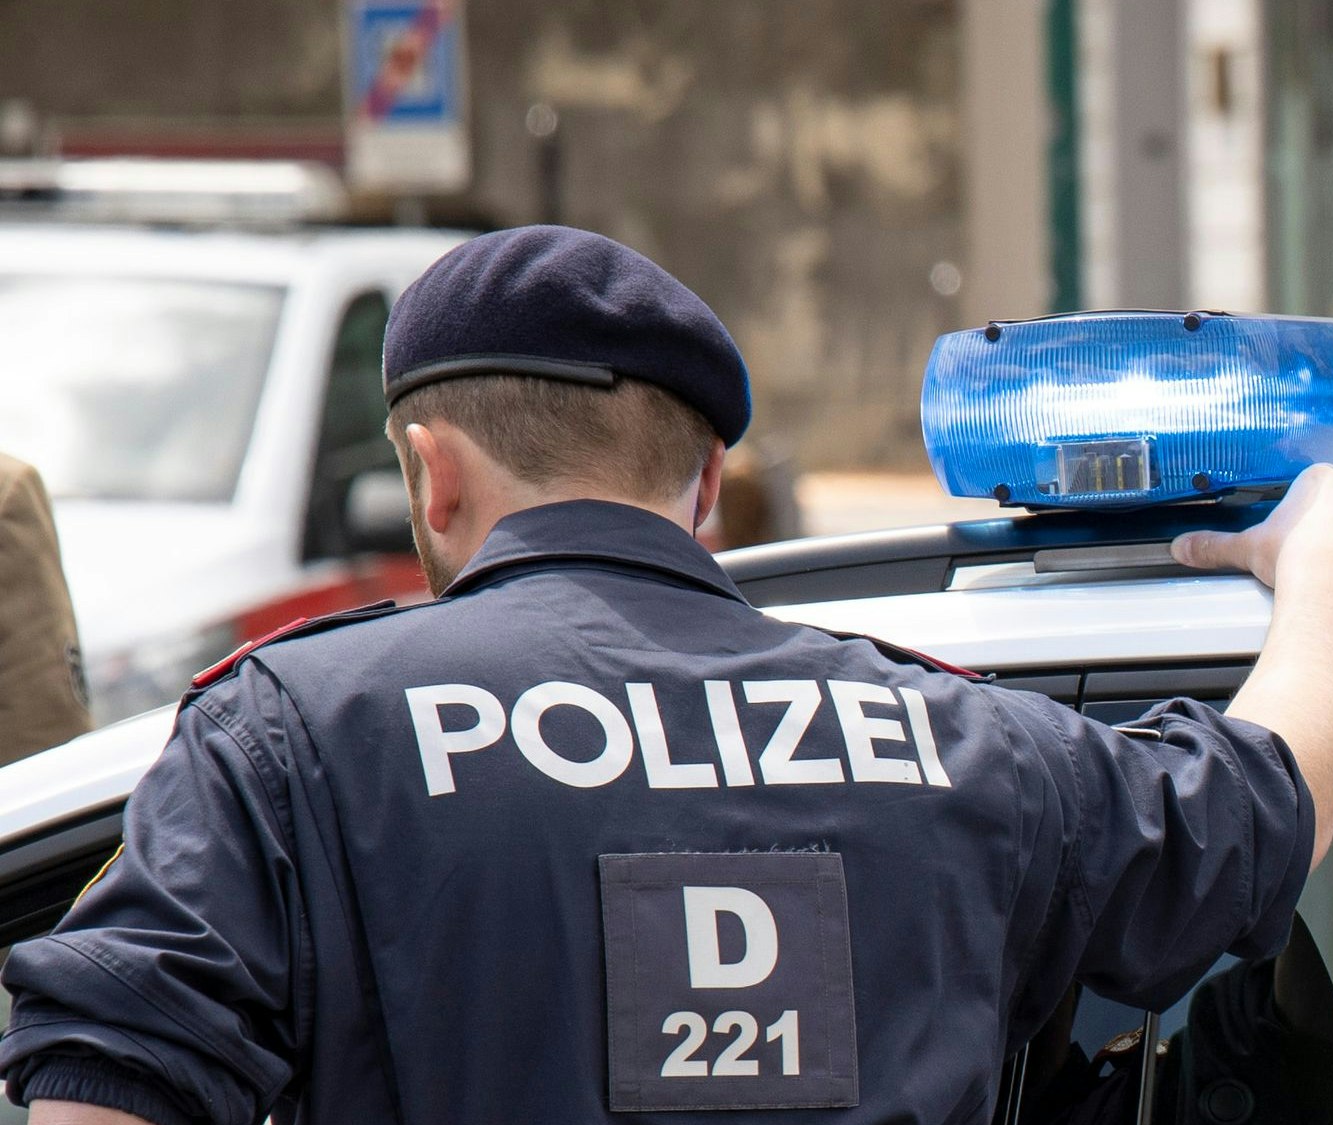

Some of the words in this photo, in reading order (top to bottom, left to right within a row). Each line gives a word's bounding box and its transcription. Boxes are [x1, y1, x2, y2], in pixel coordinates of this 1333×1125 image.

[404, 680, 951, 797] POLIZEI
[683, 886, 778, 989] D
[661, 1010, 800, 1077] 221
